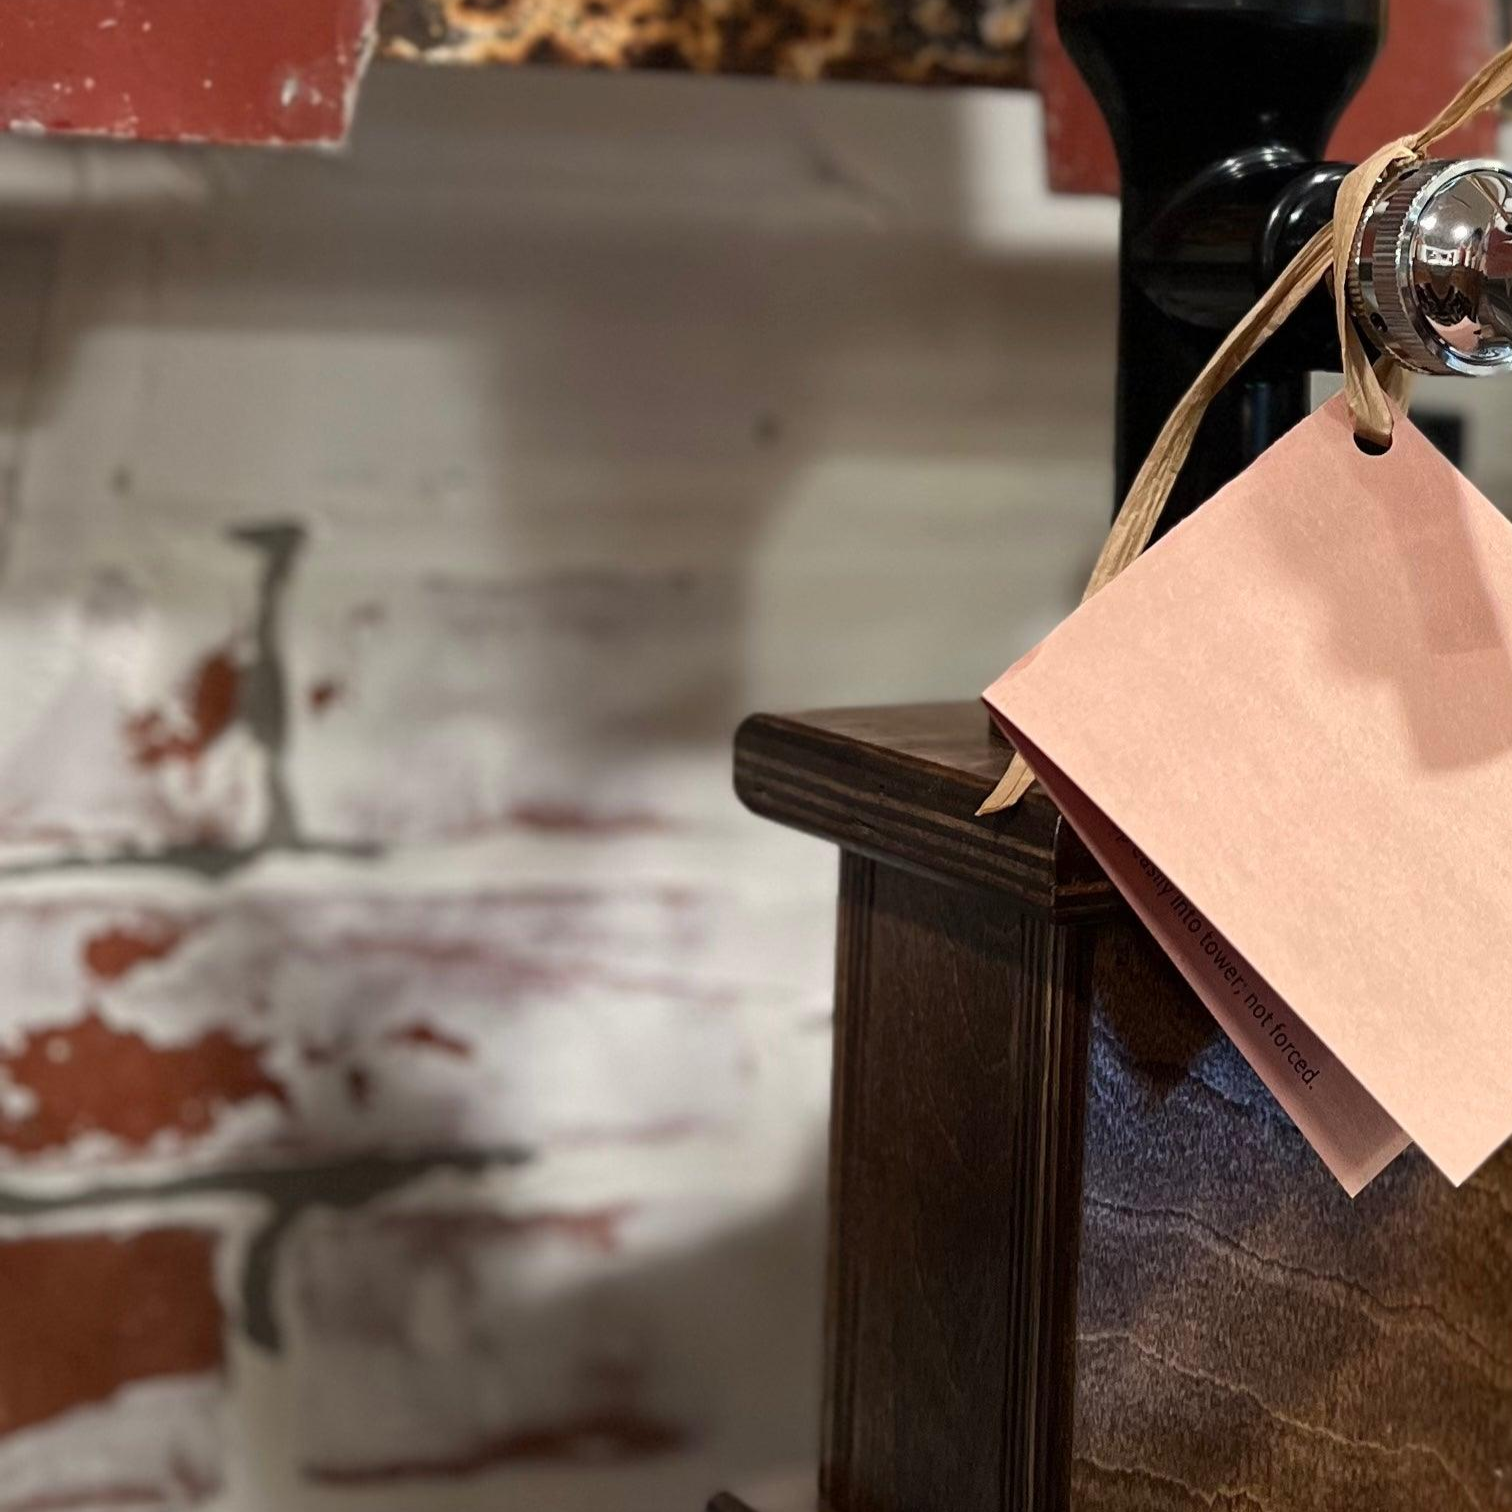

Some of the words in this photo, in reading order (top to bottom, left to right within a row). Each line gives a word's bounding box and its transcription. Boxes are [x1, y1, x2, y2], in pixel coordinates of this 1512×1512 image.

[1170, 894, 1202, 933] into
[1200, 931, 1247, 995] tower;
[1244, 992, 1274, 1028] not
[1268, 1022, 1321, 1091] forced.
